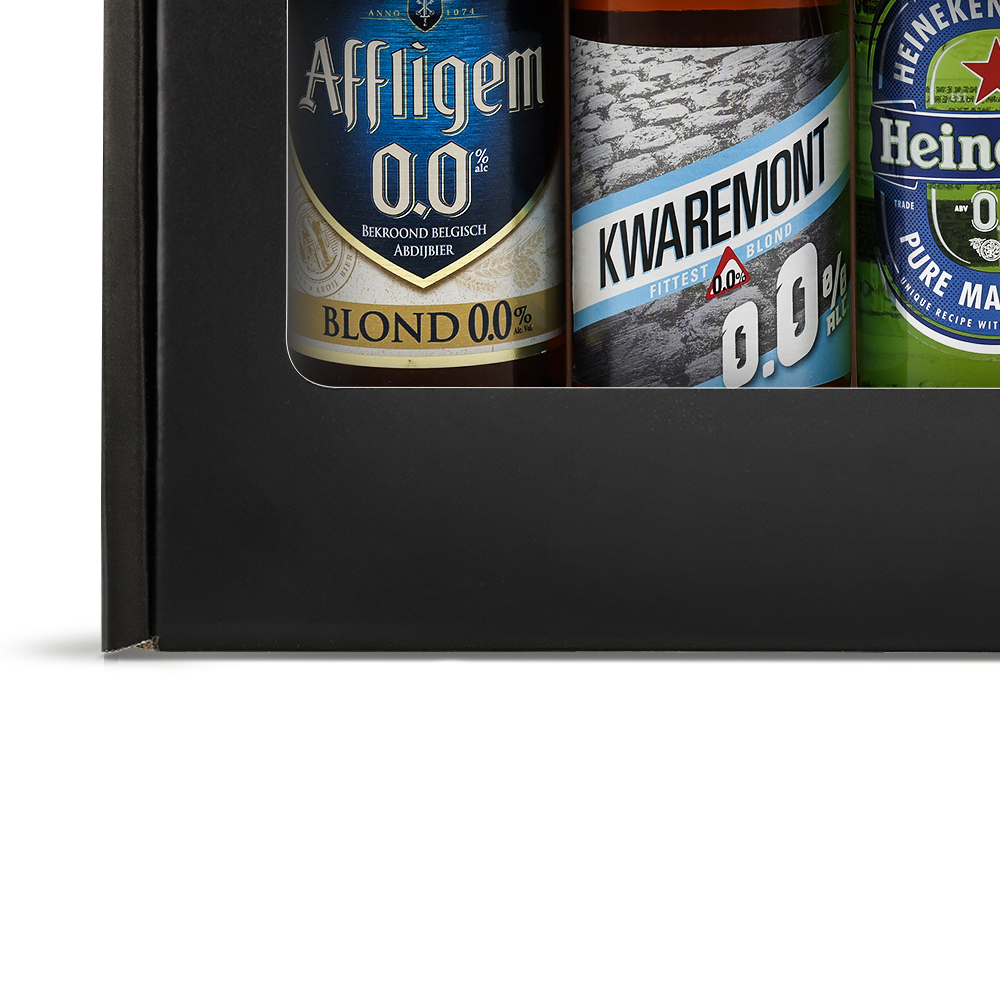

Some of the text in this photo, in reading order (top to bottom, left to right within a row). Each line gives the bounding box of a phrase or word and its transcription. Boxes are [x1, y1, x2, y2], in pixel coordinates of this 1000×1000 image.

[368, 7, 476, 18] ANNO 1074
[299, 36, 544, 136] Affligem
[951, 93, 971, 102] EST.
[475, 163, 489, 173] alc
[600, 116, 830, 290] KWAREMONT
[894, 200, 915, 210] TRADE
[954, 205, 968, 213] ABV
[362, 223, 488, 239] BEKROOND BELGISCH
[394, 243, 455, 259] ABDIJBIER
[650, 222, 793, 299] FITTEST BLOND
[900, 231, 953, 297] PURE
[712, 269, 747, 296] 0.0%
[901, 276, 932, 311] UNIQUE
[935, 309, 972, 328] RECIPE
[322, 305, 460, 343] BLOND
